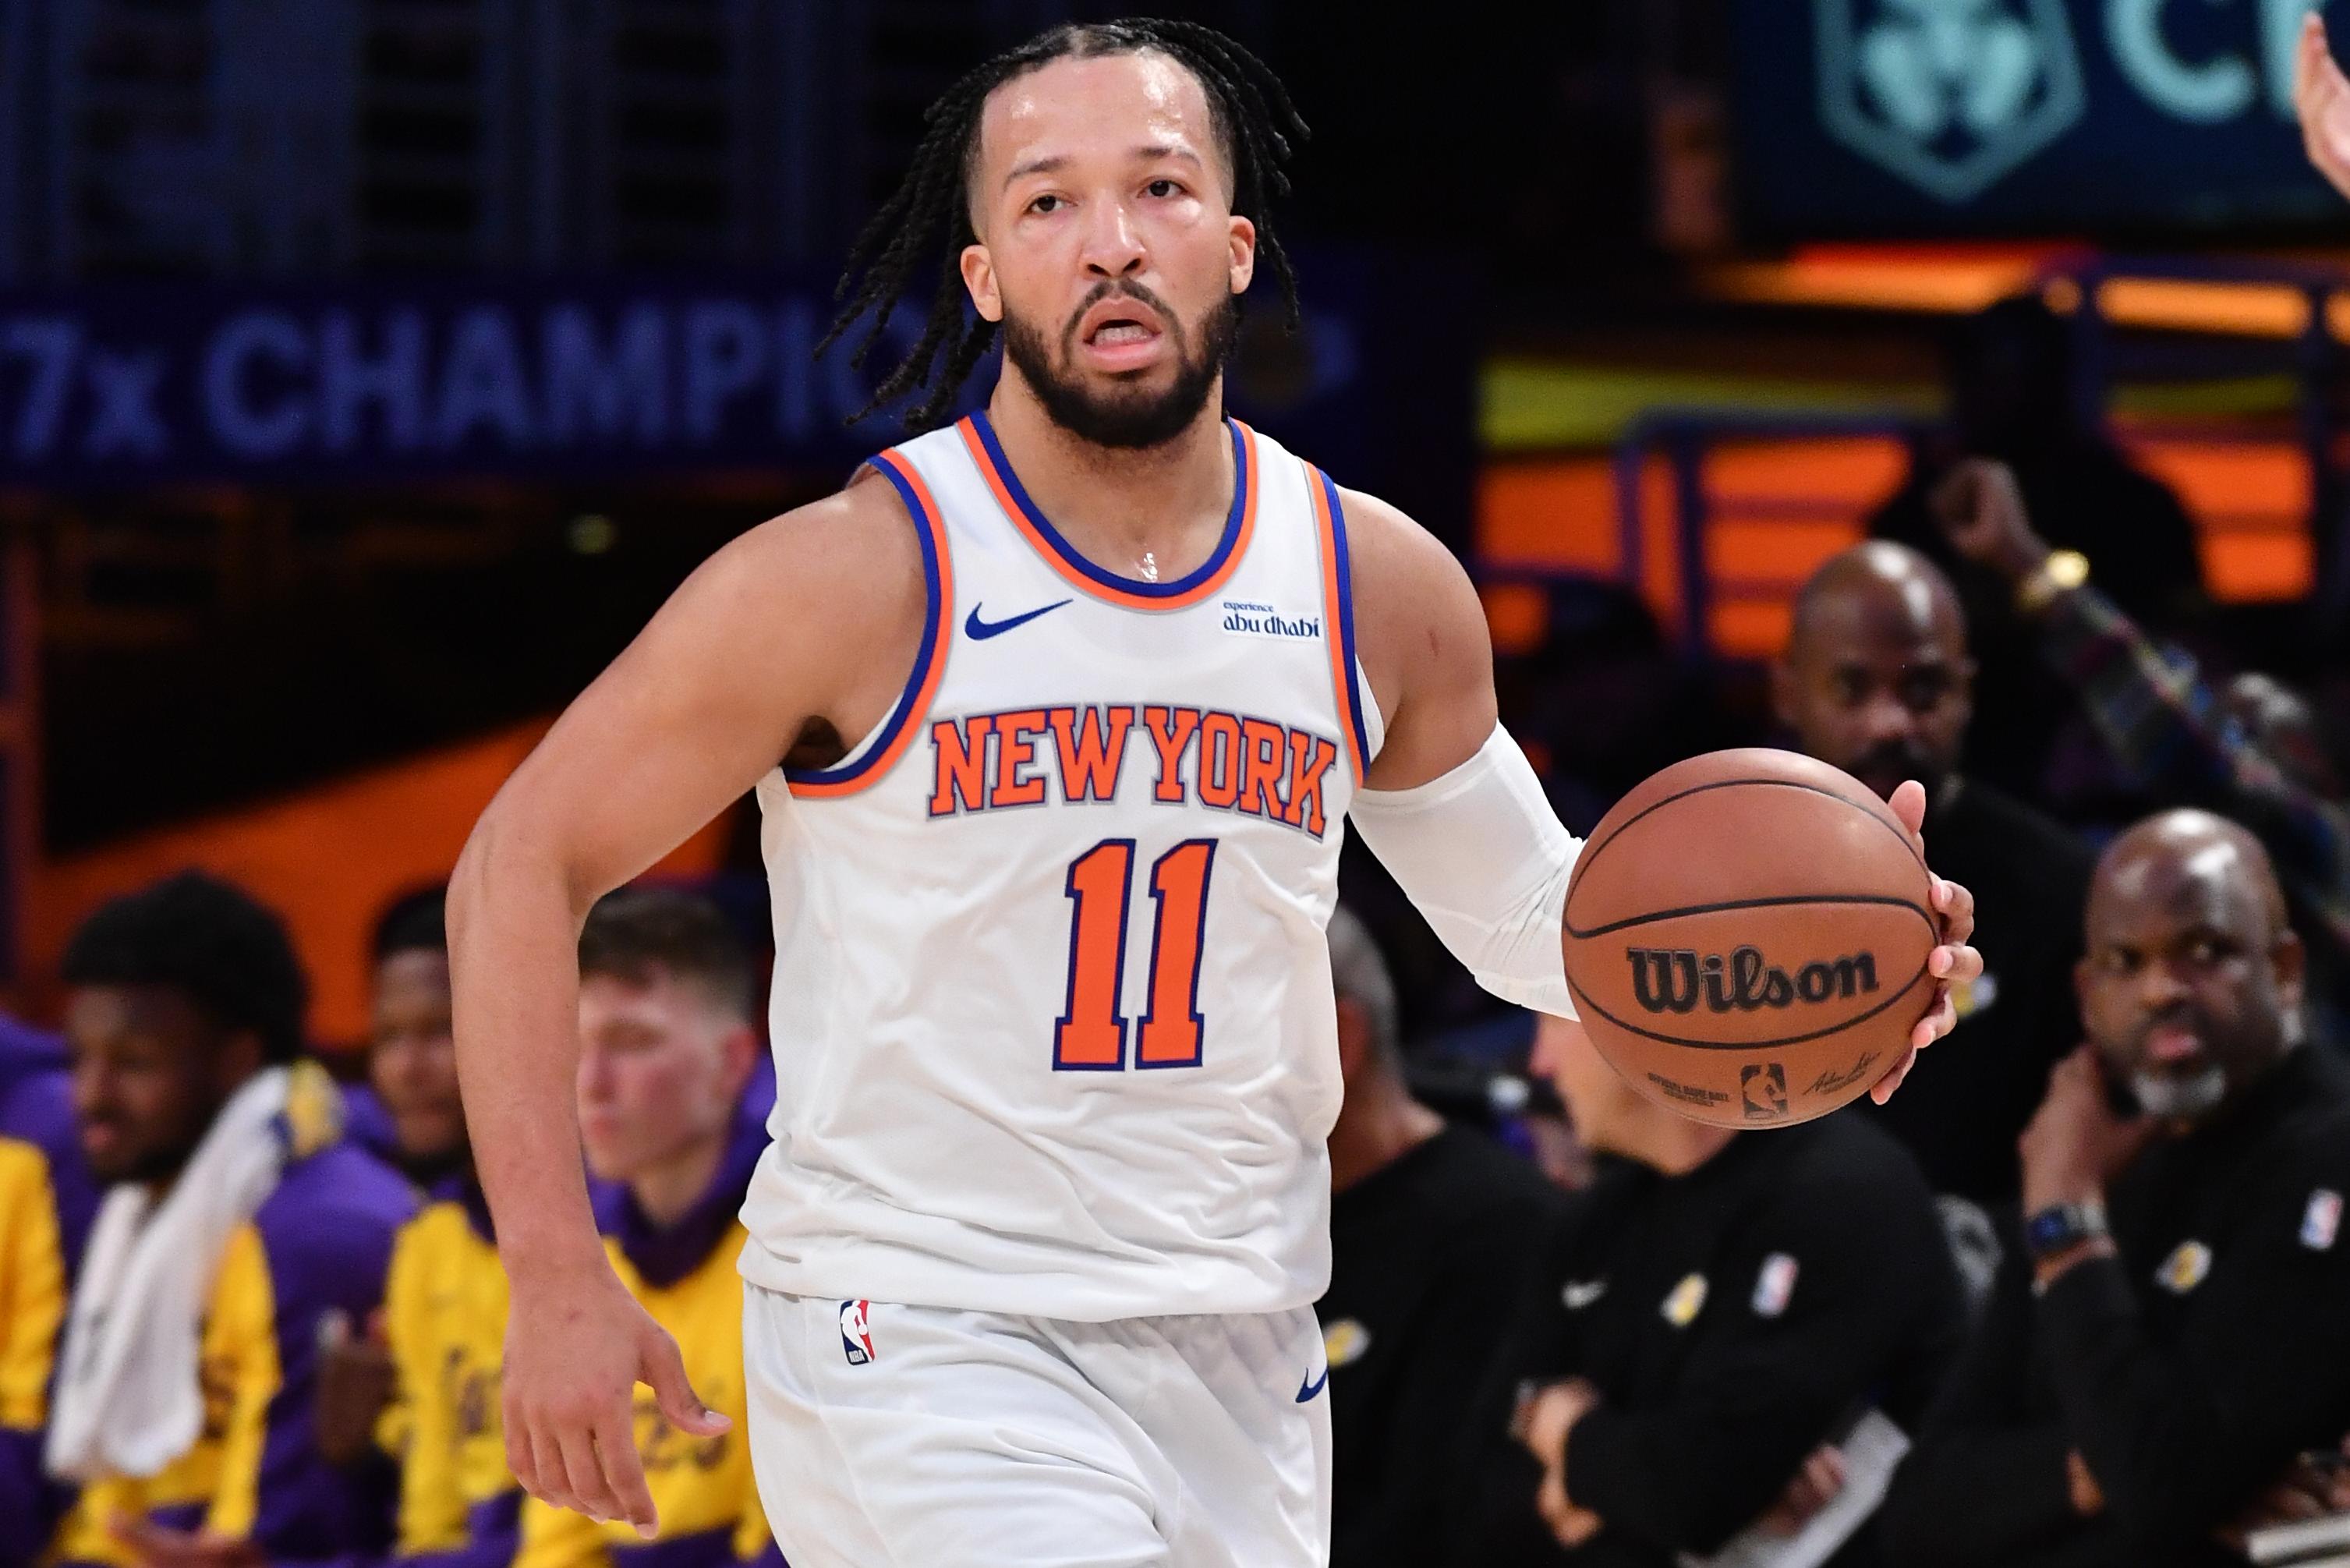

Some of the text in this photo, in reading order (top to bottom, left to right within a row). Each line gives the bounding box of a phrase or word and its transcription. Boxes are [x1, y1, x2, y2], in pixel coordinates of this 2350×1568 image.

[1223, 601, 1274, 612] experience
[1223, 613, 1319, 637] abu dhabi
[928, 703, 1338, 843] NEW YORK
[1053, 838, 1219, 1071] 11
[1626, 944, 1880, 1014] Wilson
